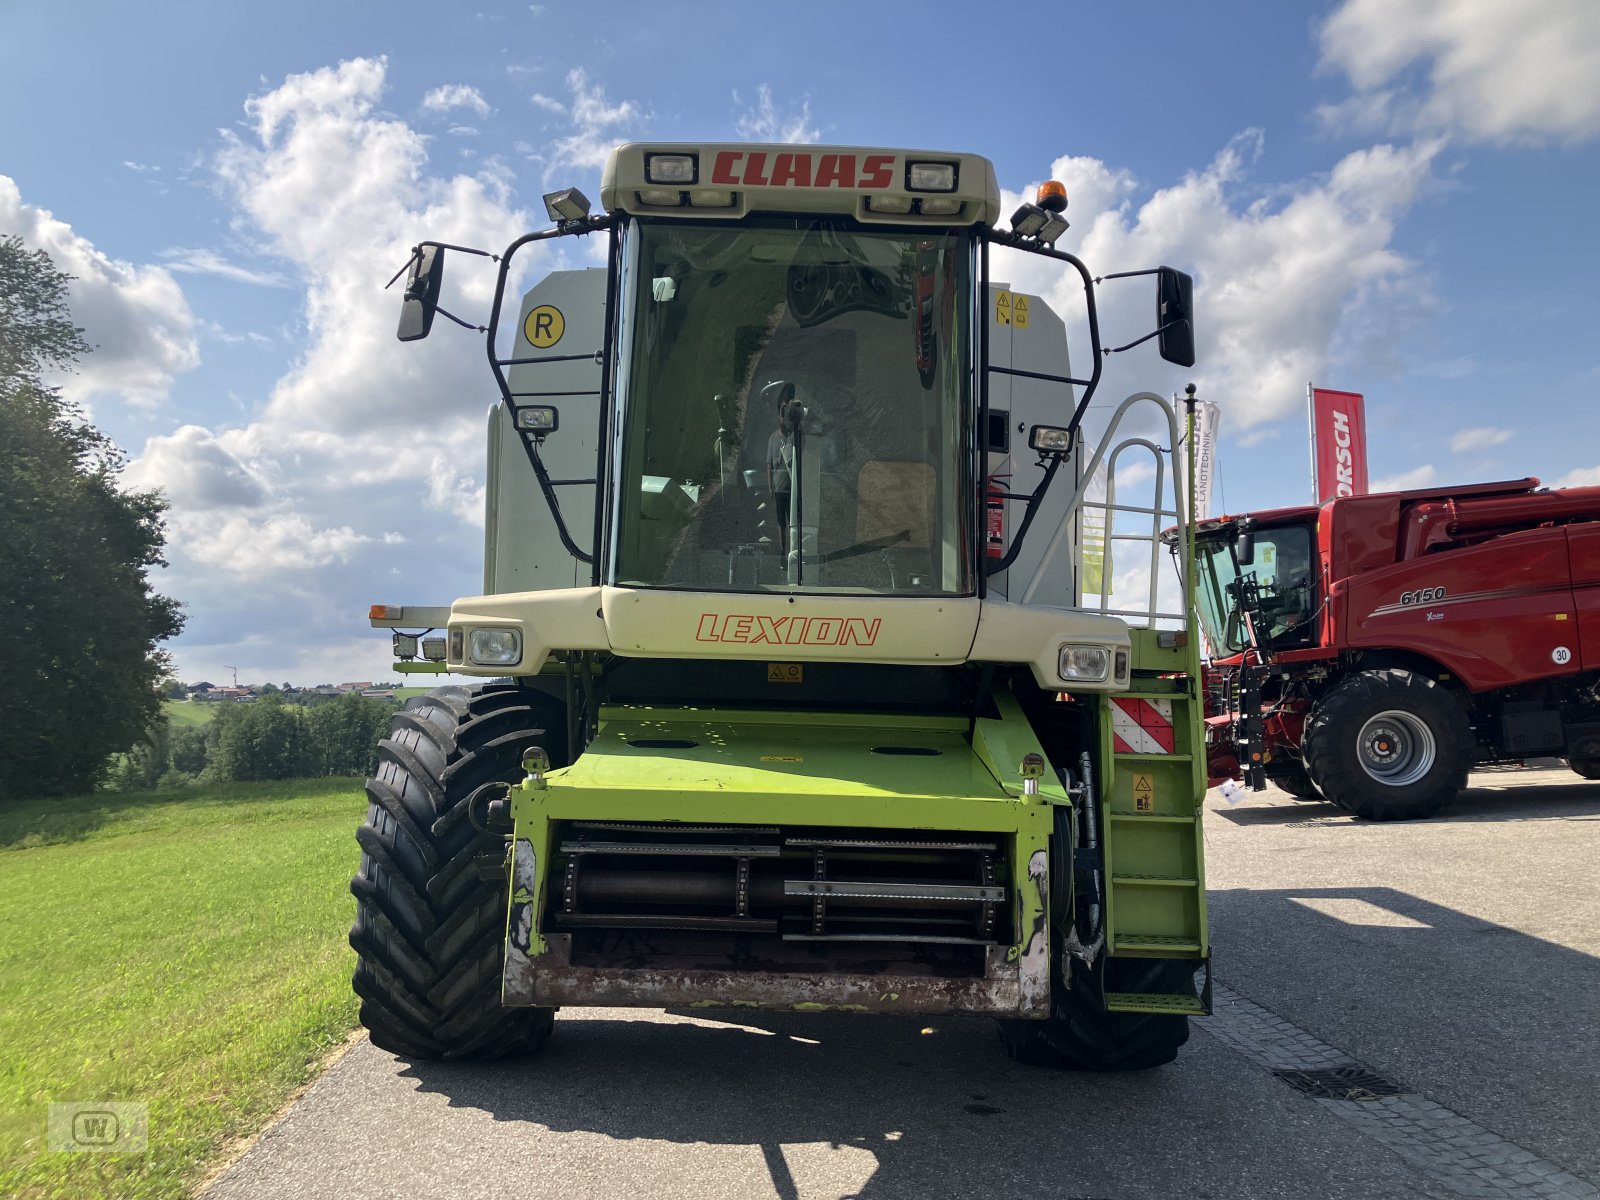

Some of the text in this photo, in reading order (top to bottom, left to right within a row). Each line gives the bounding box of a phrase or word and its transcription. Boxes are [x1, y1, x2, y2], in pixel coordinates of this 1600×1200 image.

[711, 151, 896, 188] CLAAS
[534, 312, 554, 339] R
[1199, 431, 1212, 502] LANDTECHNIK
[1400, 586, 1447, 606] 6150
[695, 613, 882, 646] LEXION
[1556, 650, 1567, 661] 30
